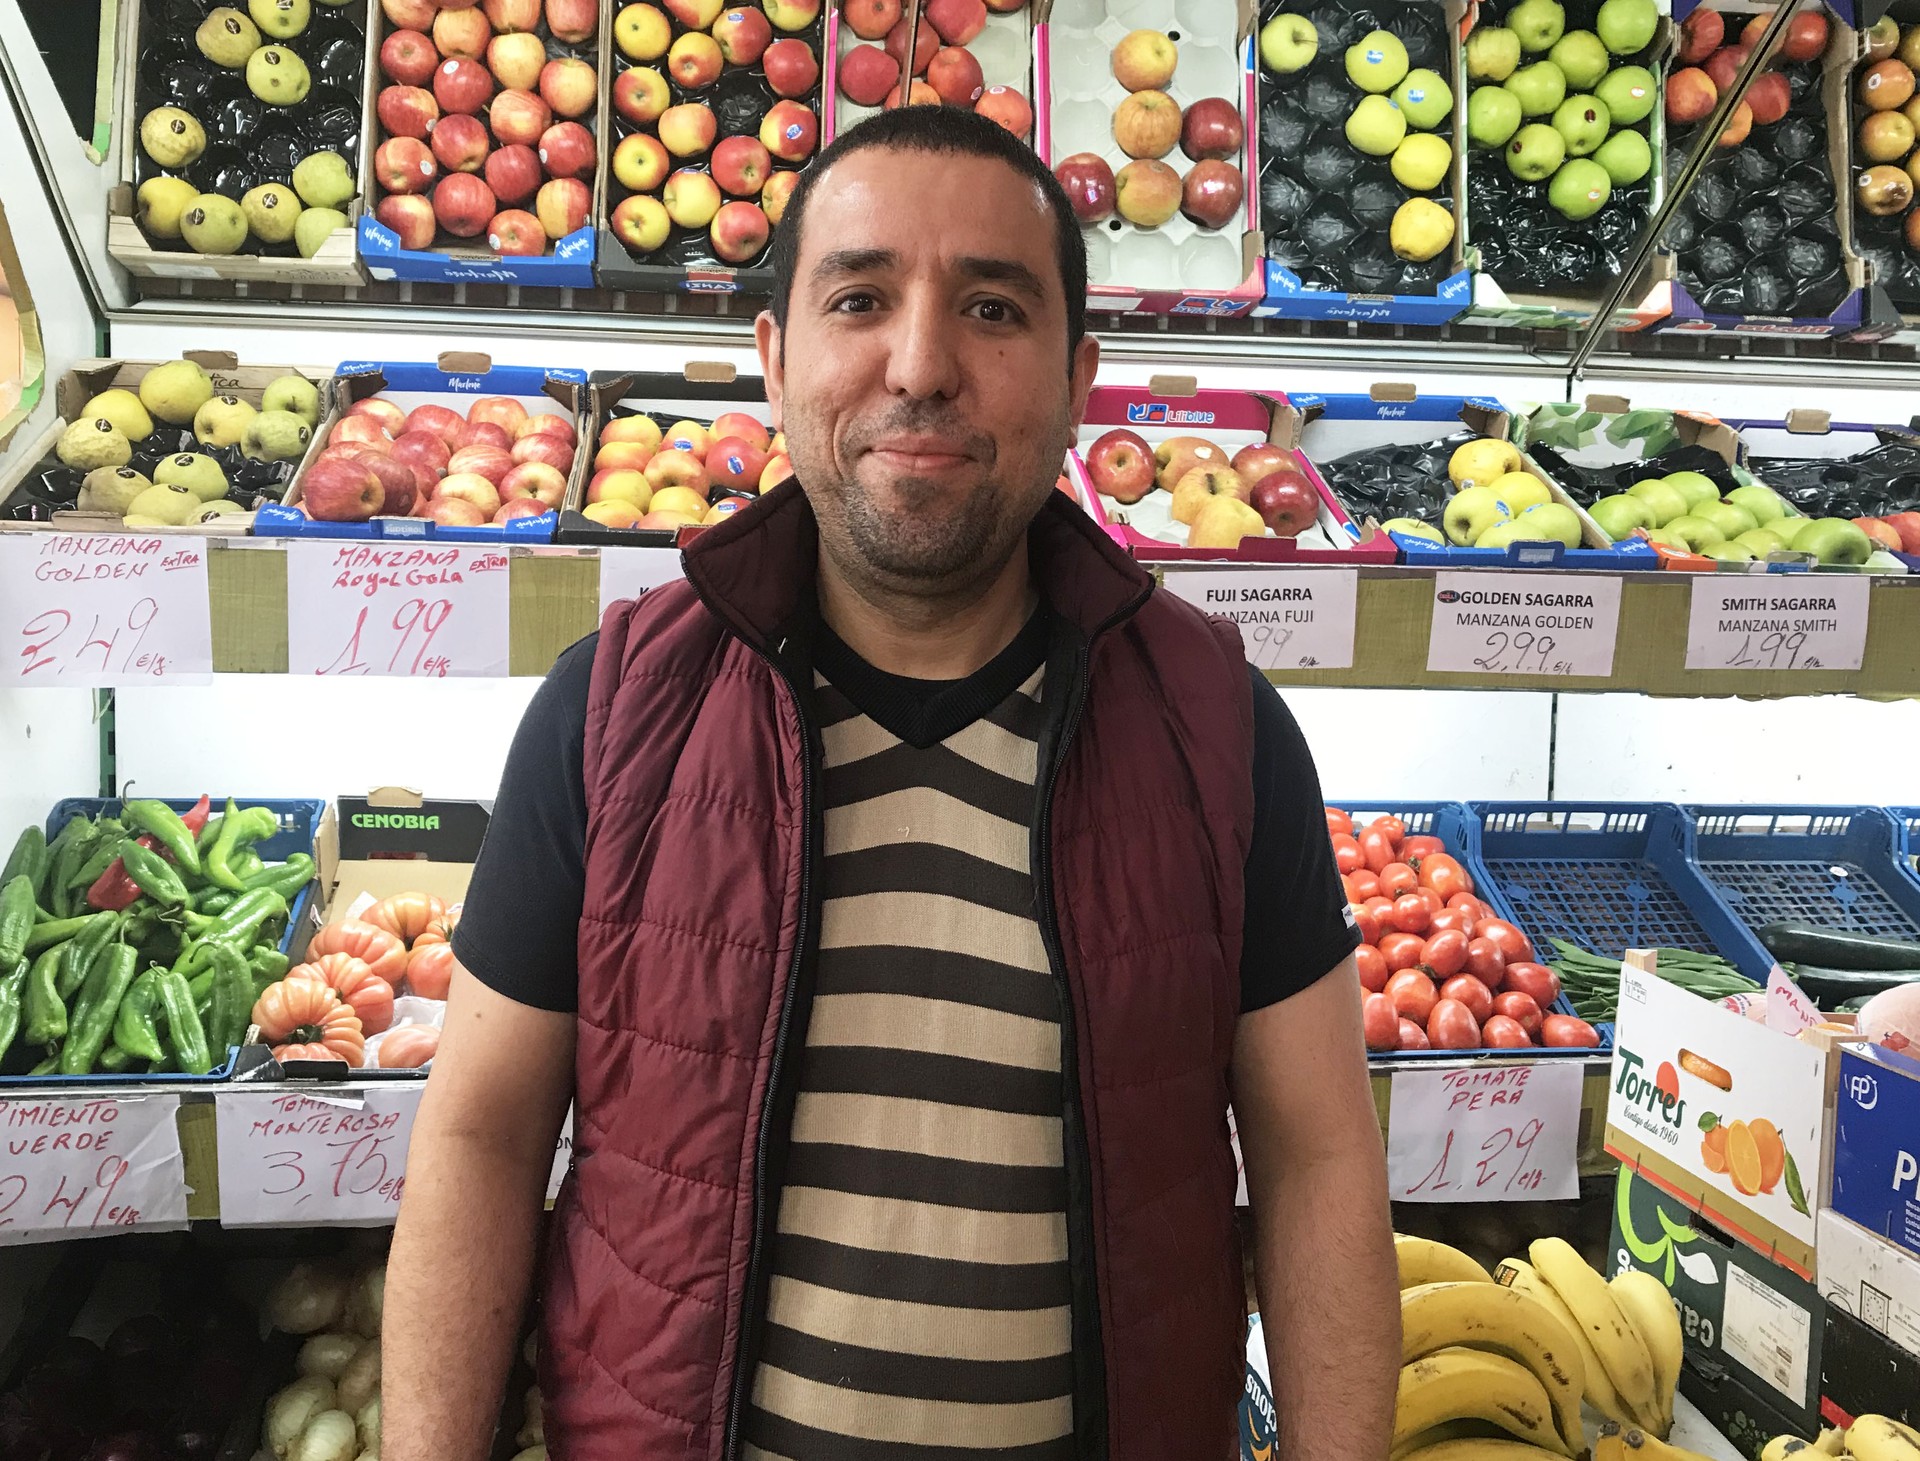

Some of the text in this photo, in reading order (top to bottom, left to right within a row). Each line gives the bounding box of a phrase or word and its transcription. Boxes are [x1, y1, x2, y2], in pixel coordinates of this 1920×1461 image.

[1167, 409, 1216, 425] Liliblue
[40, 536, 162, 556] MANZANA
[332, 545, 460, 568] MANZANA
[35, 561, 148, 582] GOLDEN
[1206, 588, 1313, 602] FUJI SAGARRA
[1460, 591, 1521, 606] GOLDEN
[1525, 593, 1594, 608] SAGARRA
[1721, 598, 1837, 611] SMITH SAGARRA
[1204, 609, 1314, 624] NZANA FUJI
[1456, 612, 1593, 630] MANZANA GOLDEN
[1718, 618, 1837, 633] MANZANA SMITH
[351, 813, 440, 831] CENOBIA
[1442, 1066, 1532, 1092] TOMATE
[1616, 1045, 1687, 1129] Torres
[1448, 1089, 1524, 1112] PERA
[9, 1131, 114, 1156] VERDE
[1659, 1126, 1679, 1146] 1960
